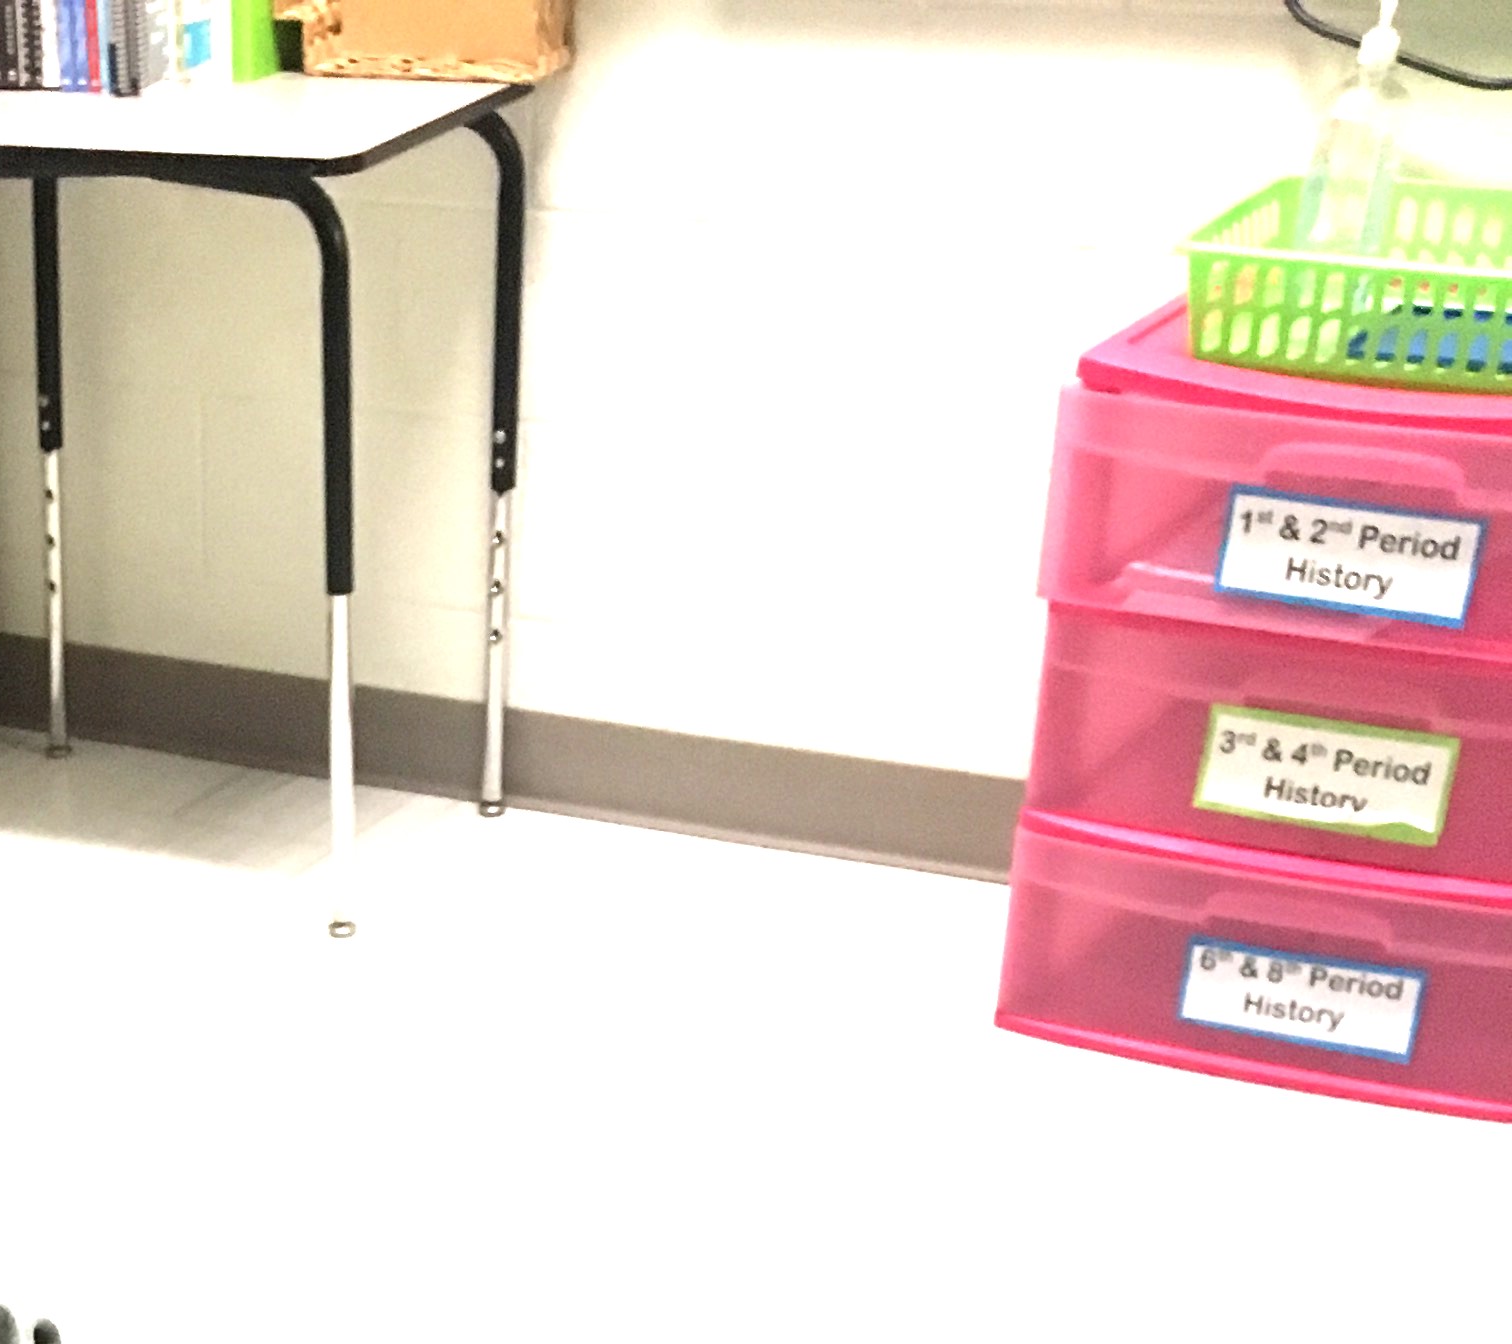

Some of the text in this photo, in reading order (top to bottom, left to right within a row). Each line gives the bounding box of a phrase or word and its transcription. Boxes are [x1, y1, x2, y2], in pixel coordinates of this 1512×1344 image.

[1240, 509, 1462, 561] 1st & 2nd Period
[1285, 557, 1394, 600] History
[1219, 730, 1432, 785] 3rd & 4th Period
[1263, 776, 1368, 813] History
[1239, 955, 1258, 979] &
[1309, 965, 1405, 1001] Period
[1243, 992, 1345, 1033] History
